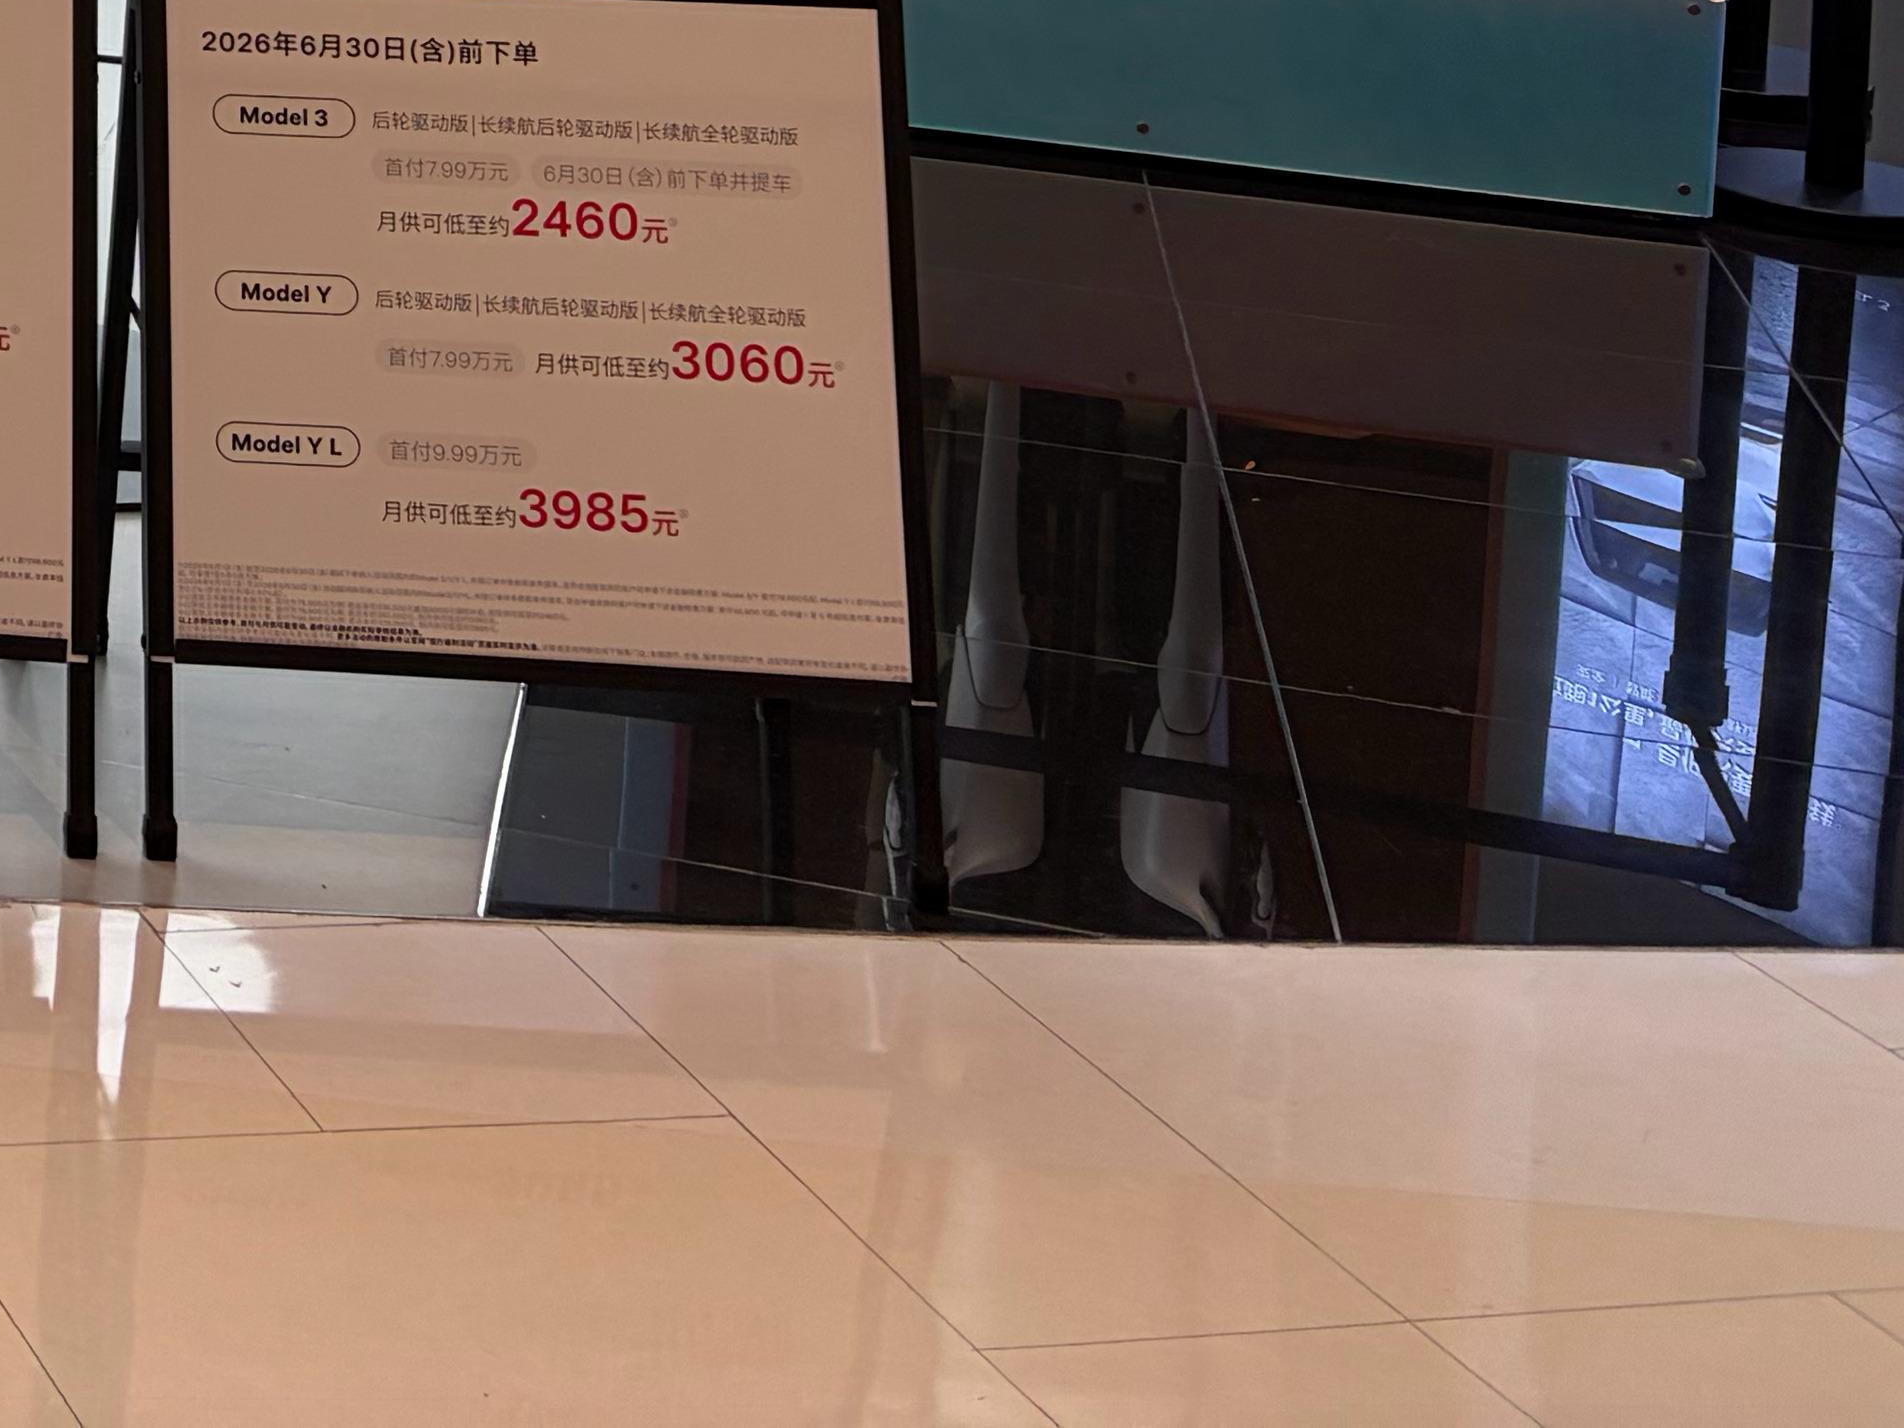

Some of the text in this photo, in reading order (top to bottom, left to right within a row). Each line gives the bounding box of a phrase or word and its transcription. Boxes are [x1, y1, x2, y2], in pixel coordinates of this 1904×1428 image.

[240, 106, 328, 127] Model 3
[385, 158, 509, 182] 首付7.99万元
[241, 283, 331, 304] Model Y
[389, 347, 513, 372] 首付7.99万元
[232, 434, 341, 456] Model Y L
[391, 440, 522, 468] 首付9.99万元
